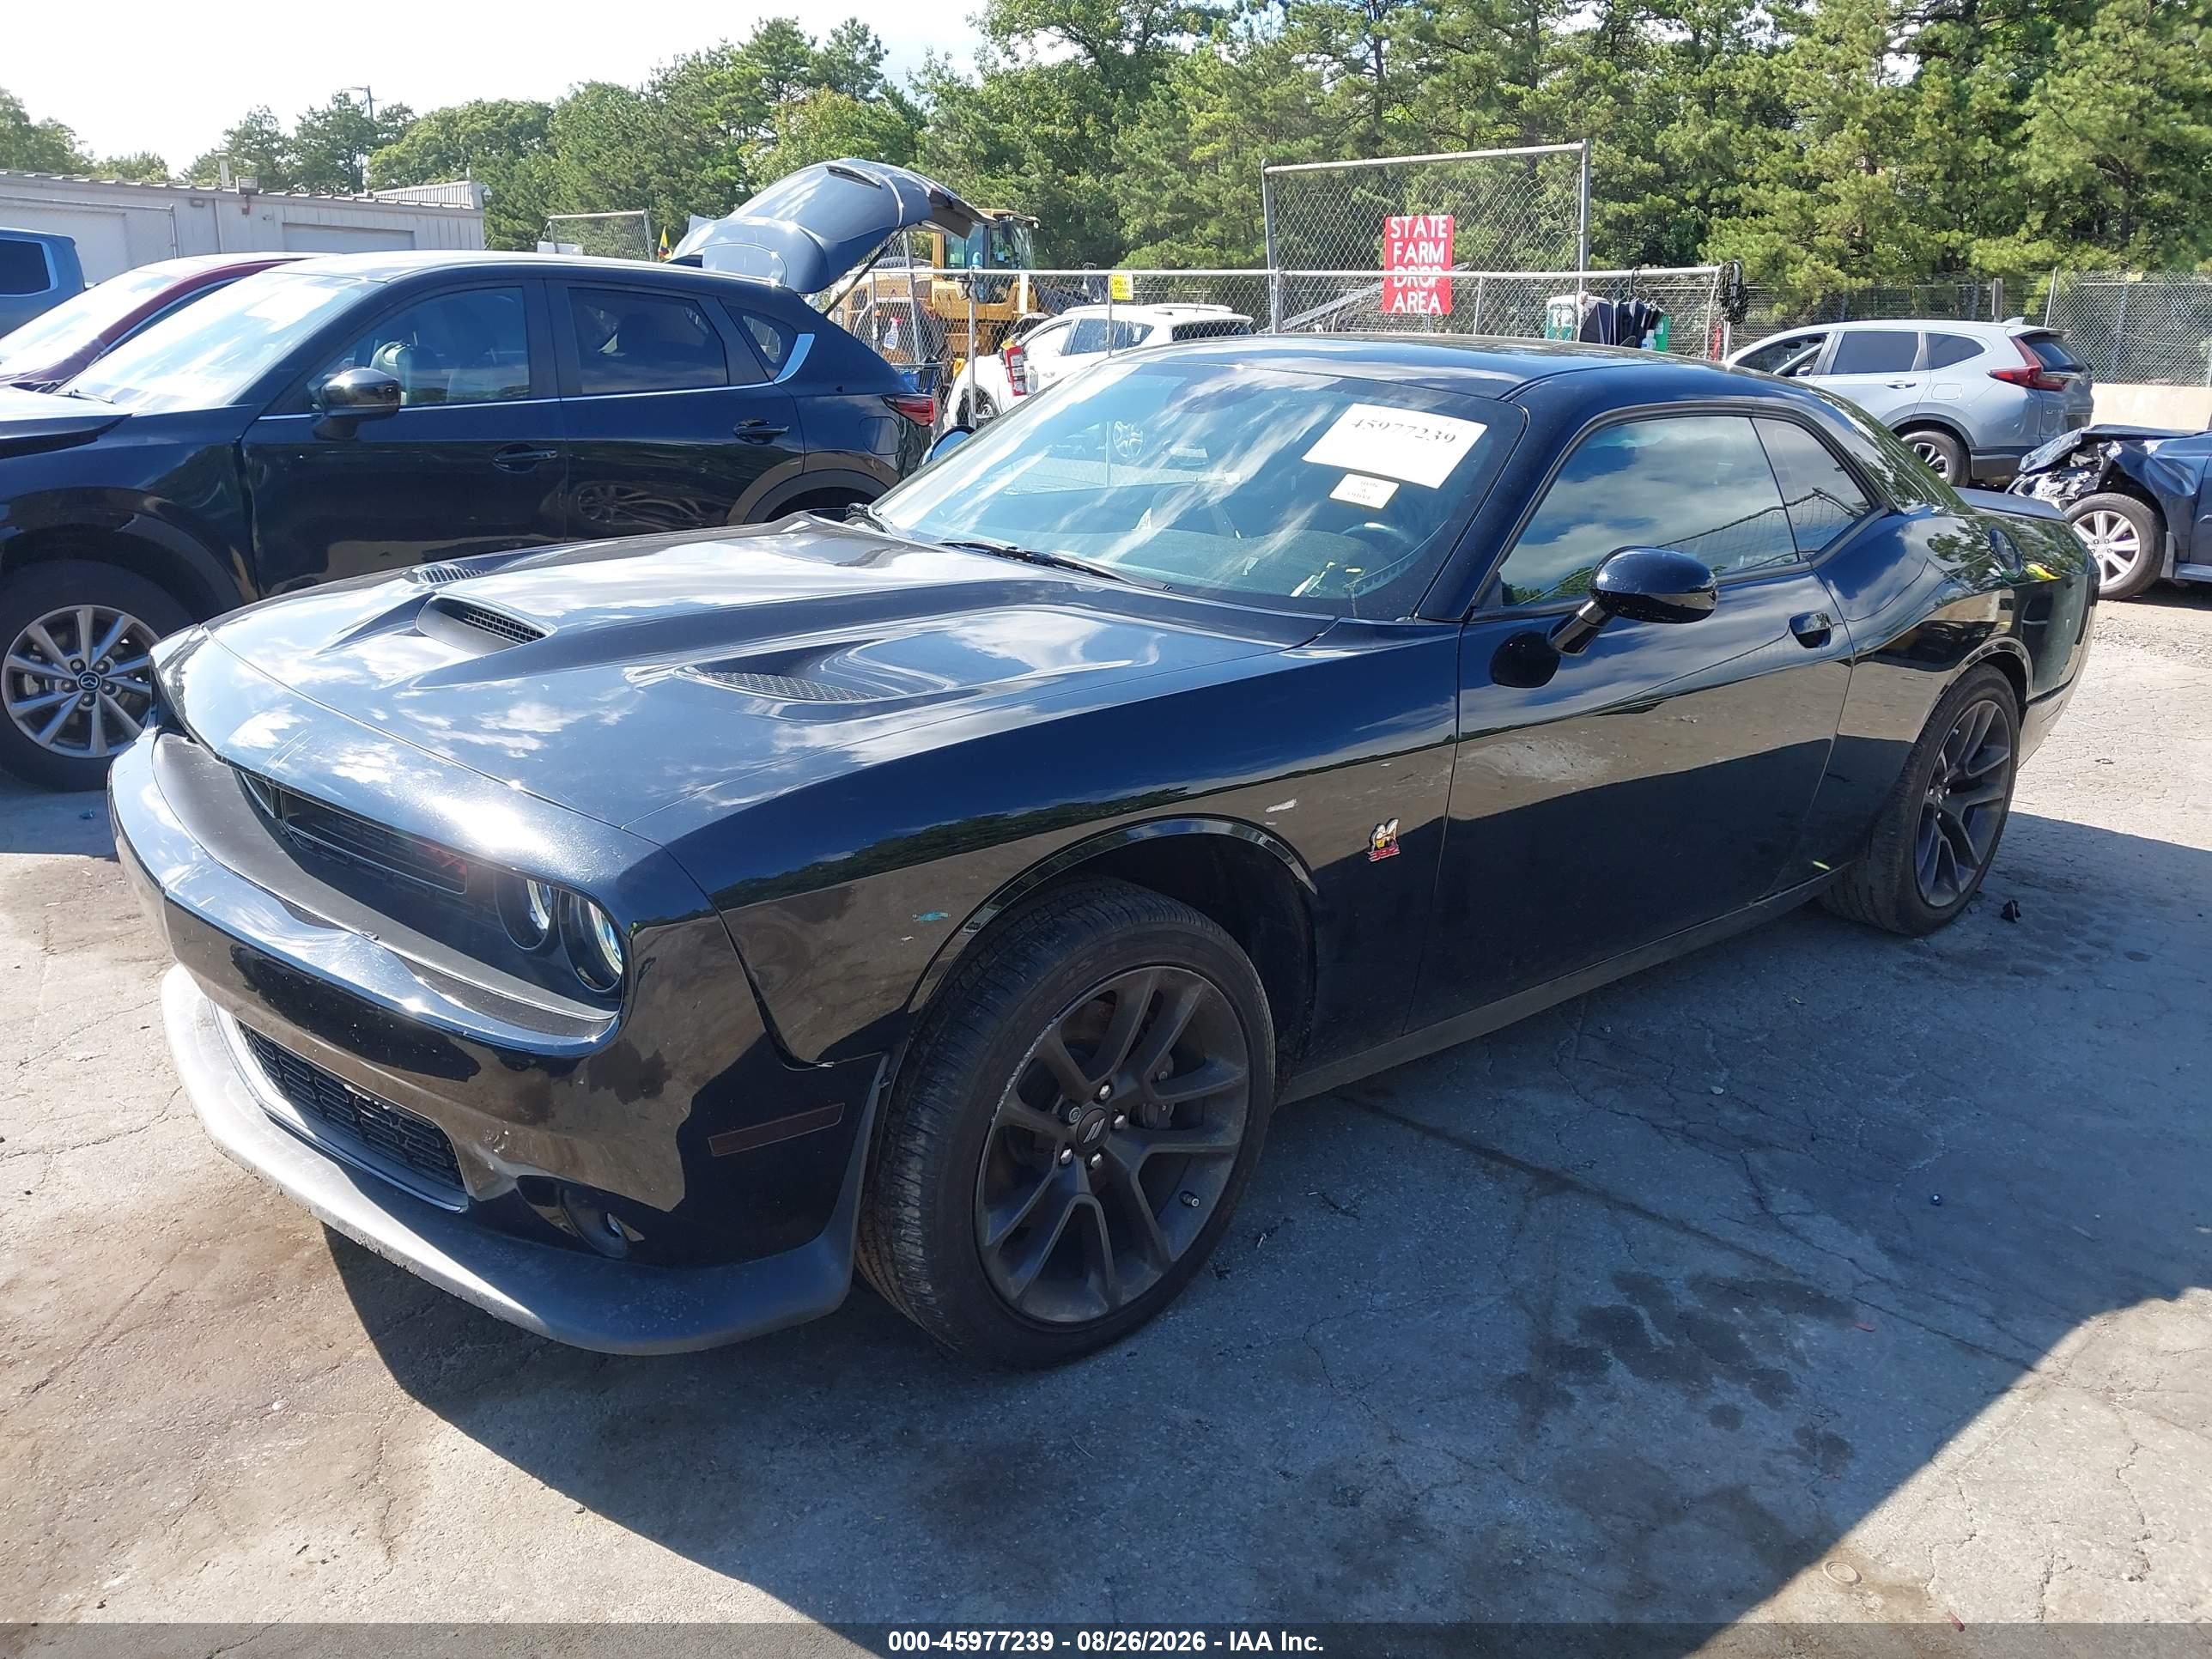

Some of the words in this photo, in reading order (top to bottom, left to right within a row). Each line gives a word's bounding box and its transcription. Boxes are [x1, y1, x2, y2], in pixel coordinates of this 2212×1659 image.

[1389, 216, 1448, 239] STATE
[1393, 241, 1445, 263] FARM
[1393, 265, 1444, 288] DROP
[1391, 291, 1443, 313] AREA
[1351, 418, 1456, 443] 45977239
[1366, 846, 1401, 862] 392
